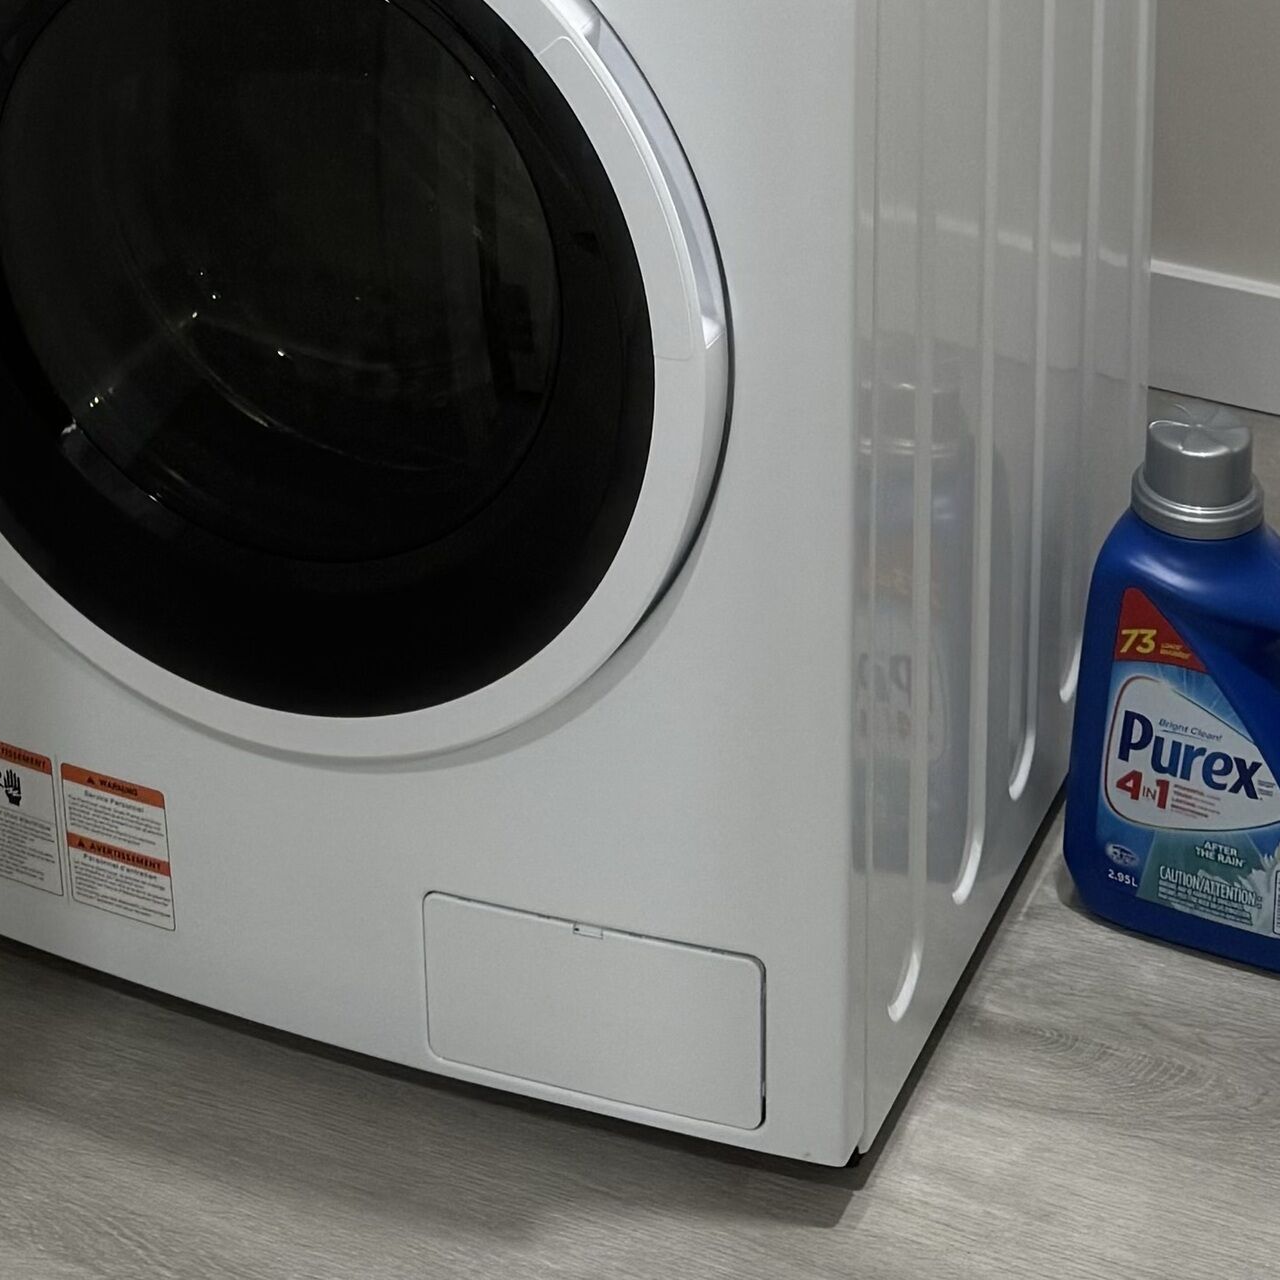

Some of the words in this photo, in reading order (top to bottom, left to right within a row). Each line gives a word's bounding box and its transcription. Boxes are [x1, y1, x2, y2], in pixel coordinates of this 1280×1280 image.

[1120, 628, 1157, 654] 73
[1117, 709, 1262, 800] Purex
[1195, 846, 1215, 860] THE
[1217, 852, 1243, 867] RAIN
[1204, 841, 1238, 856] AFTER
